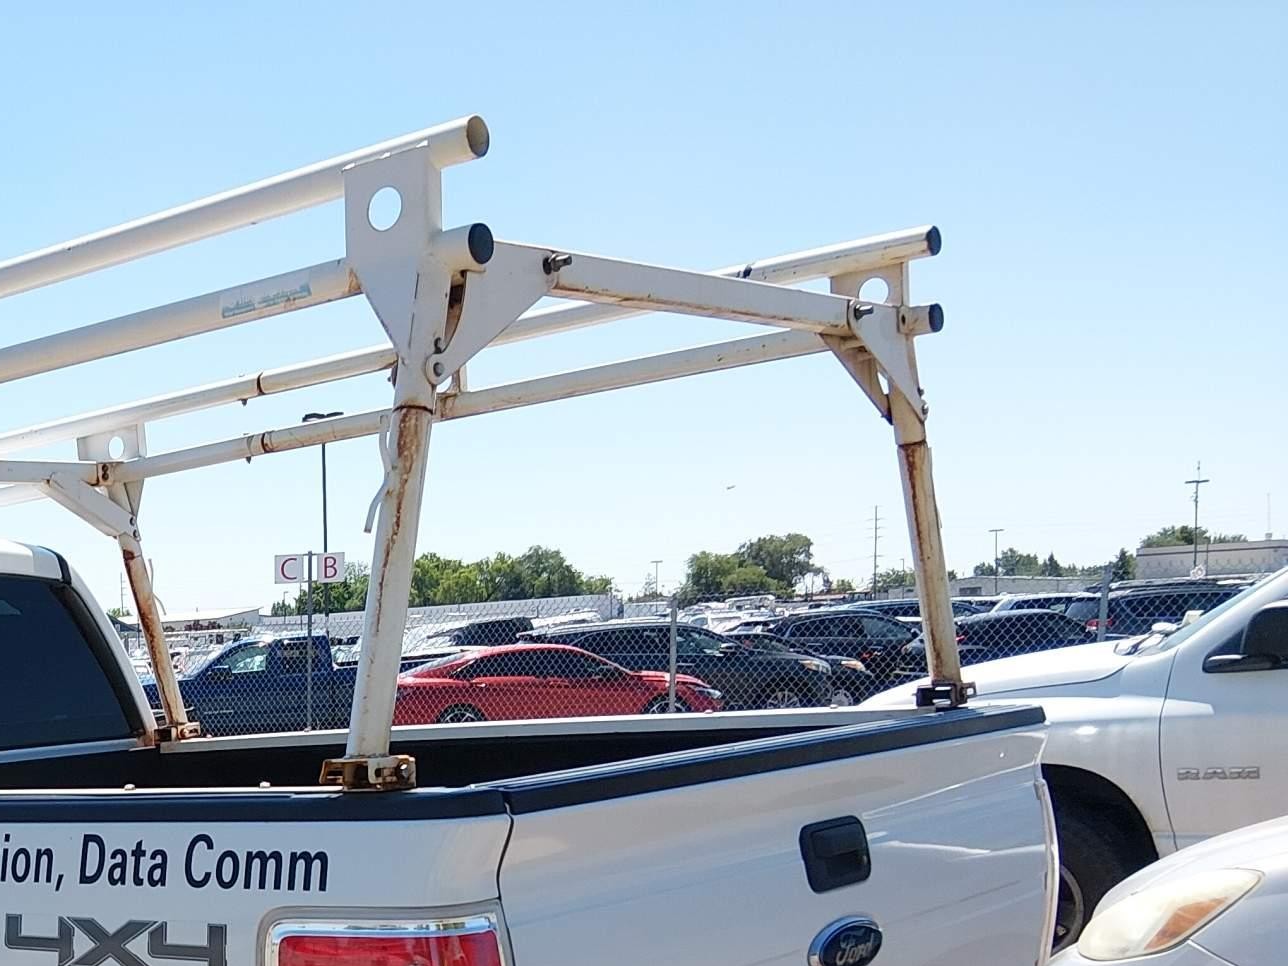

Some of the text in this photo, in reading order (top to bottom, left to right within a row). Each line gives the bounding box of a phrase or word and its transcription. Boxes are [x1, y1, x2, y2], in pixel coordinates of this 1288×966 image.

[280, 557, 298, 581] C
[323, 556, 338, 579] B
[1176, 766, 1261, 782] RAM
[78, 833, 169, 888] Data
[184, 833, 330, 892] Comm
